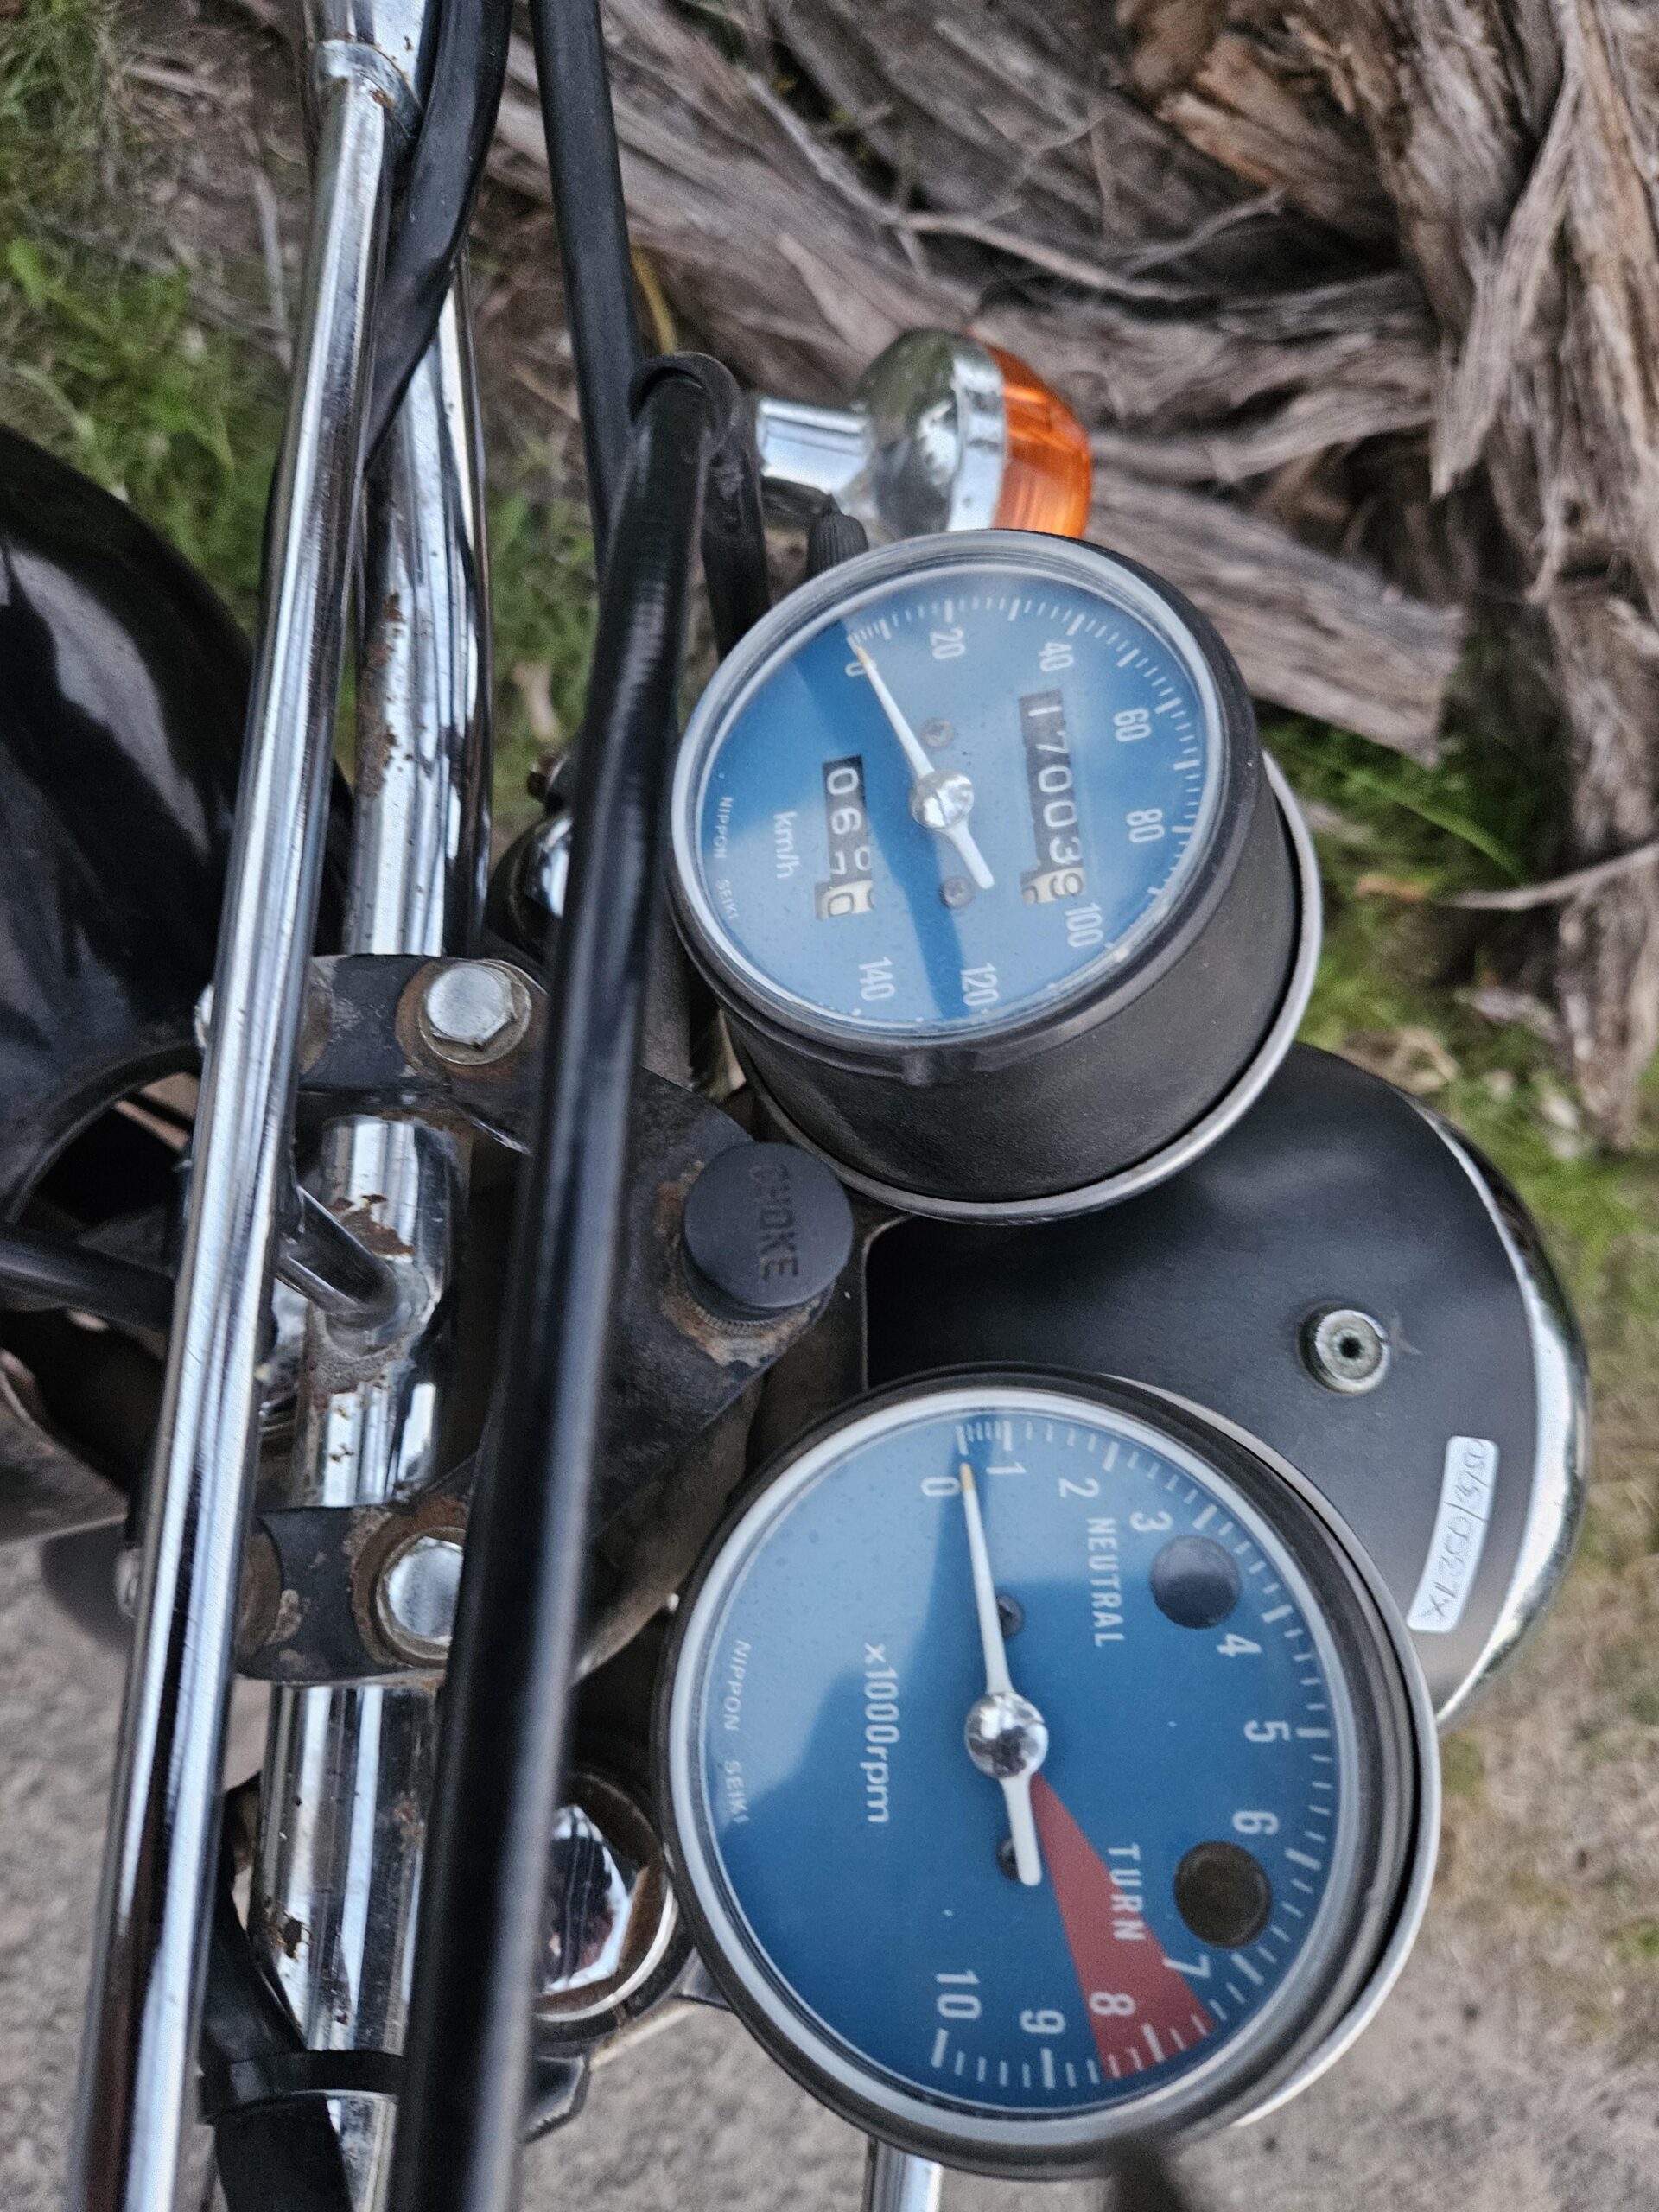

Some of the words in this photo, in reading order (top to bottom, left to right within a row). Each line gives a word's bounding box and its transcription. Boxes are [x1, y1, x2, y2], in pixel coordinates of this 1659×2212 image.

[930, 628, 966, 659] 20
[1039, 641, 1074, 672] 40
[1113, 709, 1152, 741] 60
[713, 797, 734, 860] NIPPON
[1126, 808, 1165, 843] 80
[773, 810, 799, 879] km/h
[716, 880, 738, 920] SEIKI
[1065, 904, 1103, 948] 100
[859, 957, 895, 1001] 140
[961, 963, 999, 1007] 120
[750, 1165, 799, 1281] CHOKE
[987, 1460, 1027, 1477] 1
[921, 1477, 959, 1497] 0
[1058, 1478, 1100, 1499] 2
[1130, 1511, 1171, 1532] 3
[1085, 1516, 1126, 1648] NEUTRAL
[1217, 1634, 1261, 1657] 4
[725, 1639, 753, 1732] NIPPON
[1244, 1720, 1291, 1743] 5
[725, 1760, 750, 1823] SEIKI
[1233, 1810, 1278, 1834] 6
[1108, 1844, 1146, 1942] TURN
[1163, 1955, 1211, 1979] 7
[934, 1970, 982, 2020] 10
[1089, 1992, 1136, 2016] 8
[1020, 2010, 1065, 2035] 9
